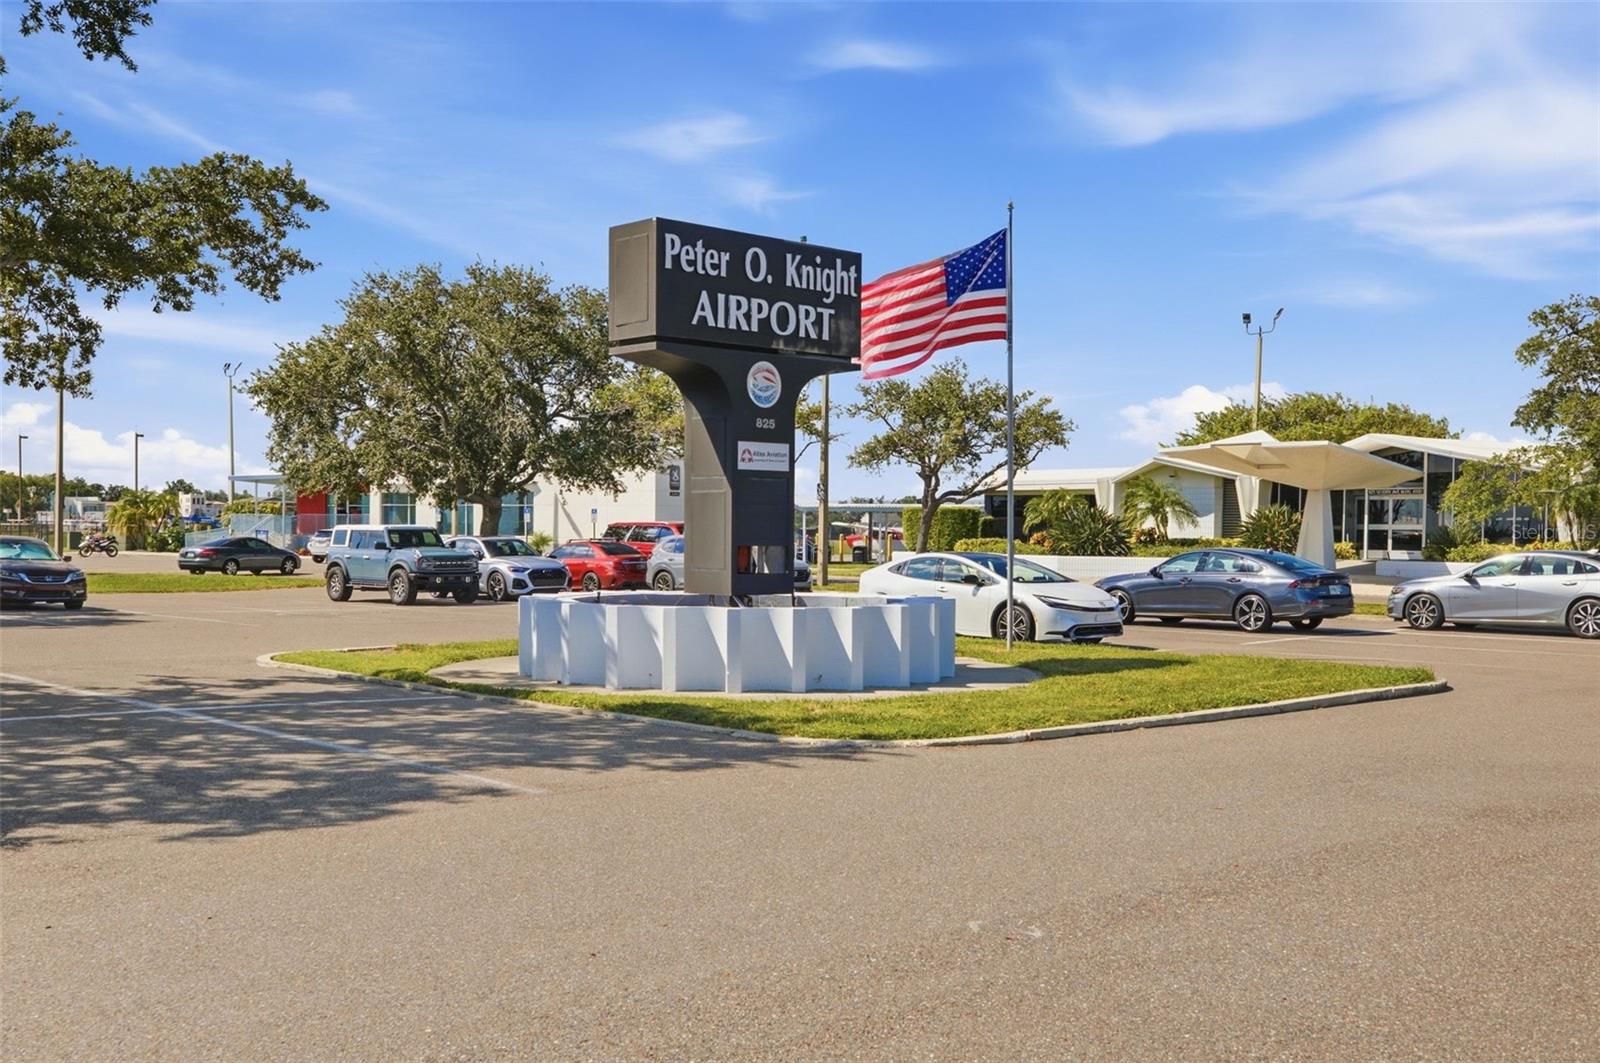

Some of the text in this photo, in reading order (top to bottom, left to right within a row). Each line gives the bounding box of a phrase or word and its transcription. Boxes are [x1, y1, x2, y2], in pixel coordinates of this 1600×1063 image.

[664, 233, 858, 304] Peter O. Knight
[691, 290, 836, 341] AIRPORT
[755, 418, 776, 429] 825
